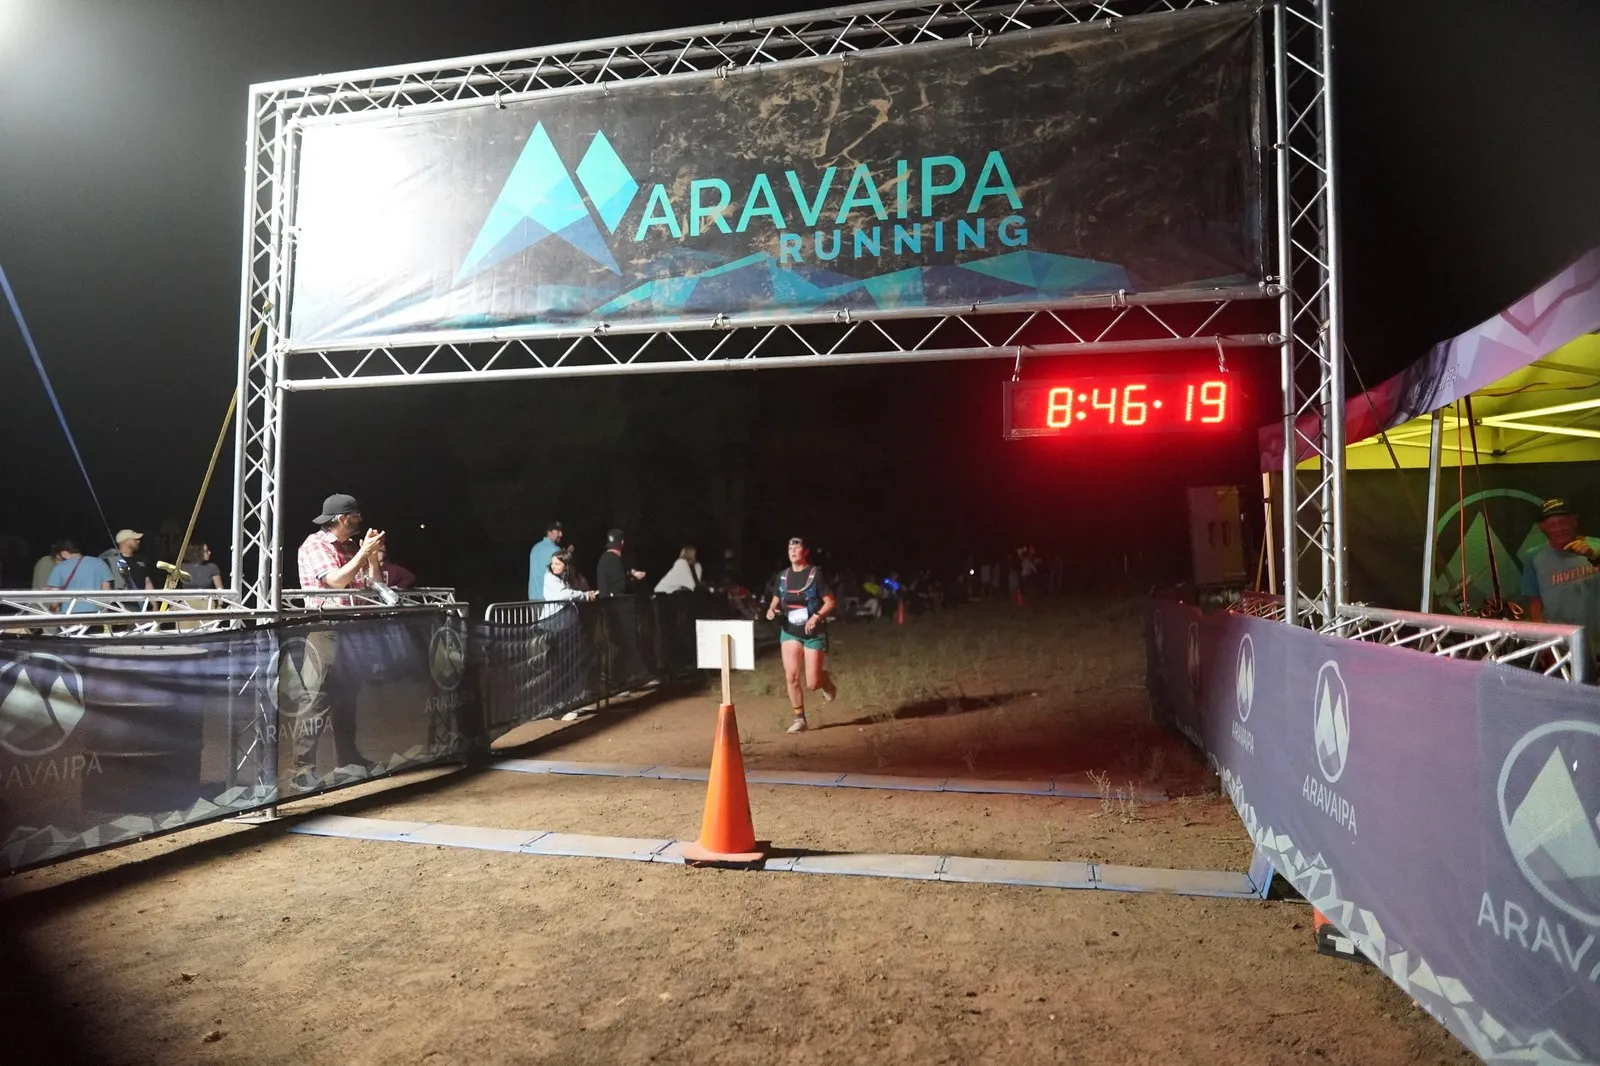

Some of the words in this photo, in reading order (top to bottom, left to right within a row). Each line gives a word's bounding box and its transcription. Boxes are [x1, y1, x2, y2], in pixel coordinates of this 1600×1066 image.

[634, 150, 1023, 242] ARAVAIPA
[779, 214, 1028, 264] RUNNING
[0, 751, 103, 790] AVAIPA
[1302, 773, 1357, 836] ARAVAIPA
